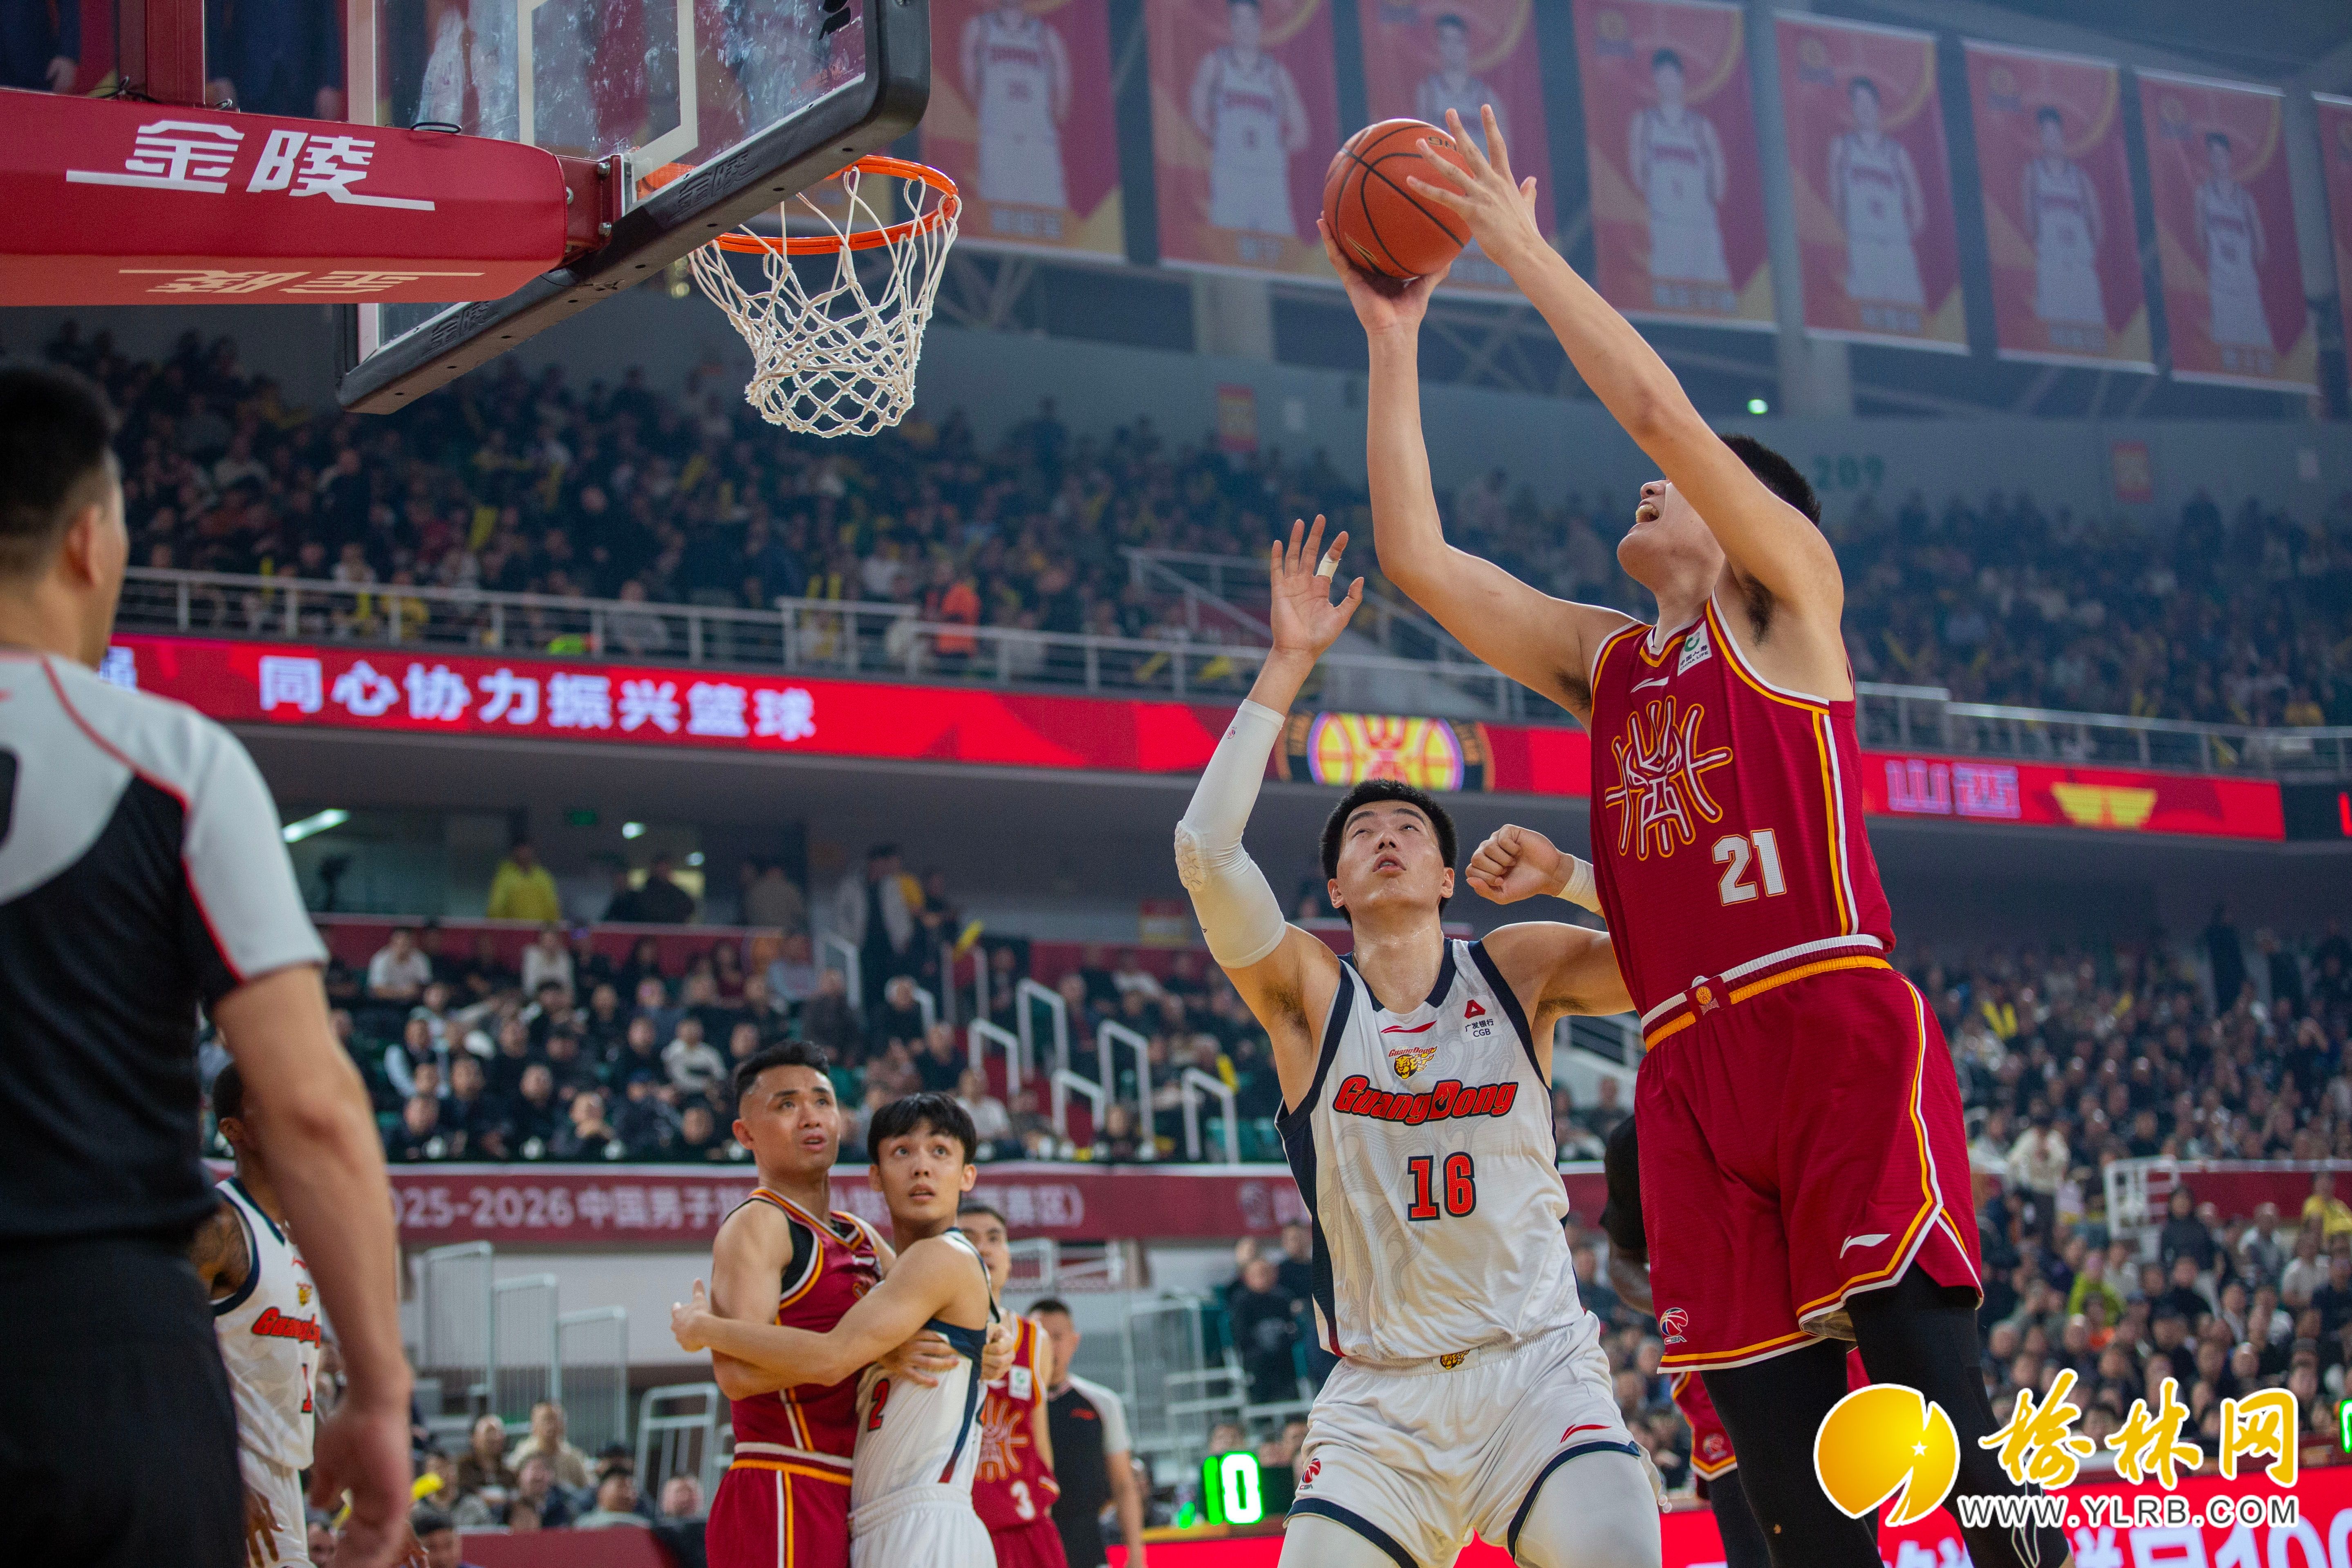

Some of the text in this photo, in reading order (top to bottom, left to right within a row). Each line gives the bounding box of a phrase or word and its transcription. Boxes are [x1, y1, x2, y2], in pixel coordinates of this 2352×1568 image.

[66, 119, 436, 211] 金陵
[1680, 645, 1708, 666] 中国人寿
[1680, 651, 1709, 670] CHINA LIFE
[258, 654, 818, 741] 同心协力振兴篮球
[1884, 759, 2022, 819] 山西
[1712, 828, 1787, 907] 21
[1465, 1019, 1494, 1032] 广发银行
[1473, 1028, 1491, 1037] CGB
[1333, 1074, 1519, 1127] GuangDong
[1408, 1151, 1477, 1221] 16
[1664, 1335, 1687, 1345] CBA
[1010, 1480, 1036, 1521] 3
